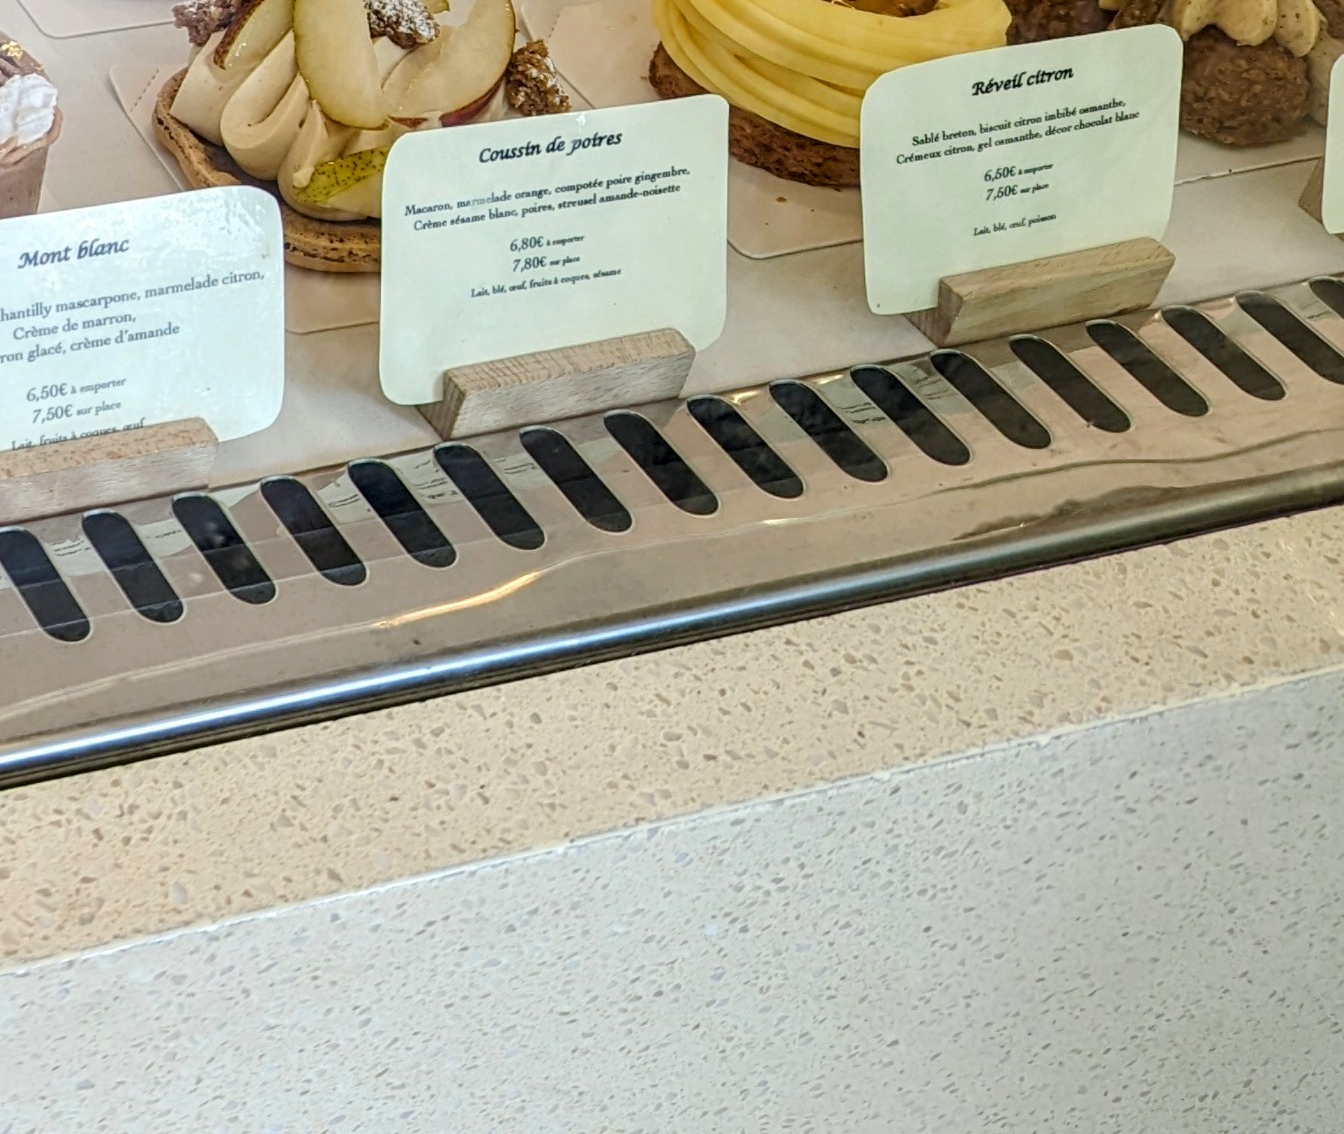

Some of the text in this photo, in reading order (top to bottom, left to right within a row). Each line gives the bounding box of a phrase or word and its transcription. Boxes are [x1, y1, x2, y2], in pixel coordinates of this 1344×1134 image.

[971, 67, 1075, 97] Réveil citron
[911, 97, 1126, 147] Sablé breton, biscuit citron imbibé osmanthe,
[478, 131, 623, 164] Coussin de poires
[895, 111, 1140, 165] Crémeux citron, gel osmanthe, décor chocolat blanc
[983, 165, 1017, 183] 6,50€
[404, 165, 691, 217] Macaron, marmelade orange, compotée poire gingembre,
[985, 184, 1019, 202] 7,50€
[413, 184, 681, 232] Crème sésame blanc, poires, streusel amande-noisette
[17, 237, 130, 270] Mont blanc
[509, 235, 544, 253] 6,80€
[512, 255, 547, 273] 7,80€
[55, 291, 141, 313] mascarpone,
[144, 273, 219, 299] marmelade
[221, 271, 265, 286] citron,
[12, 313, 137, 341] Crème de marron,
[26, 341, 67, 363] glacé,
[69, 337, 112, 352] crème
[114, 321, 180, 345] d'amande
[26, 382, 68, 403] 6,50€
[32, 403, 74, 424] 7,50€
